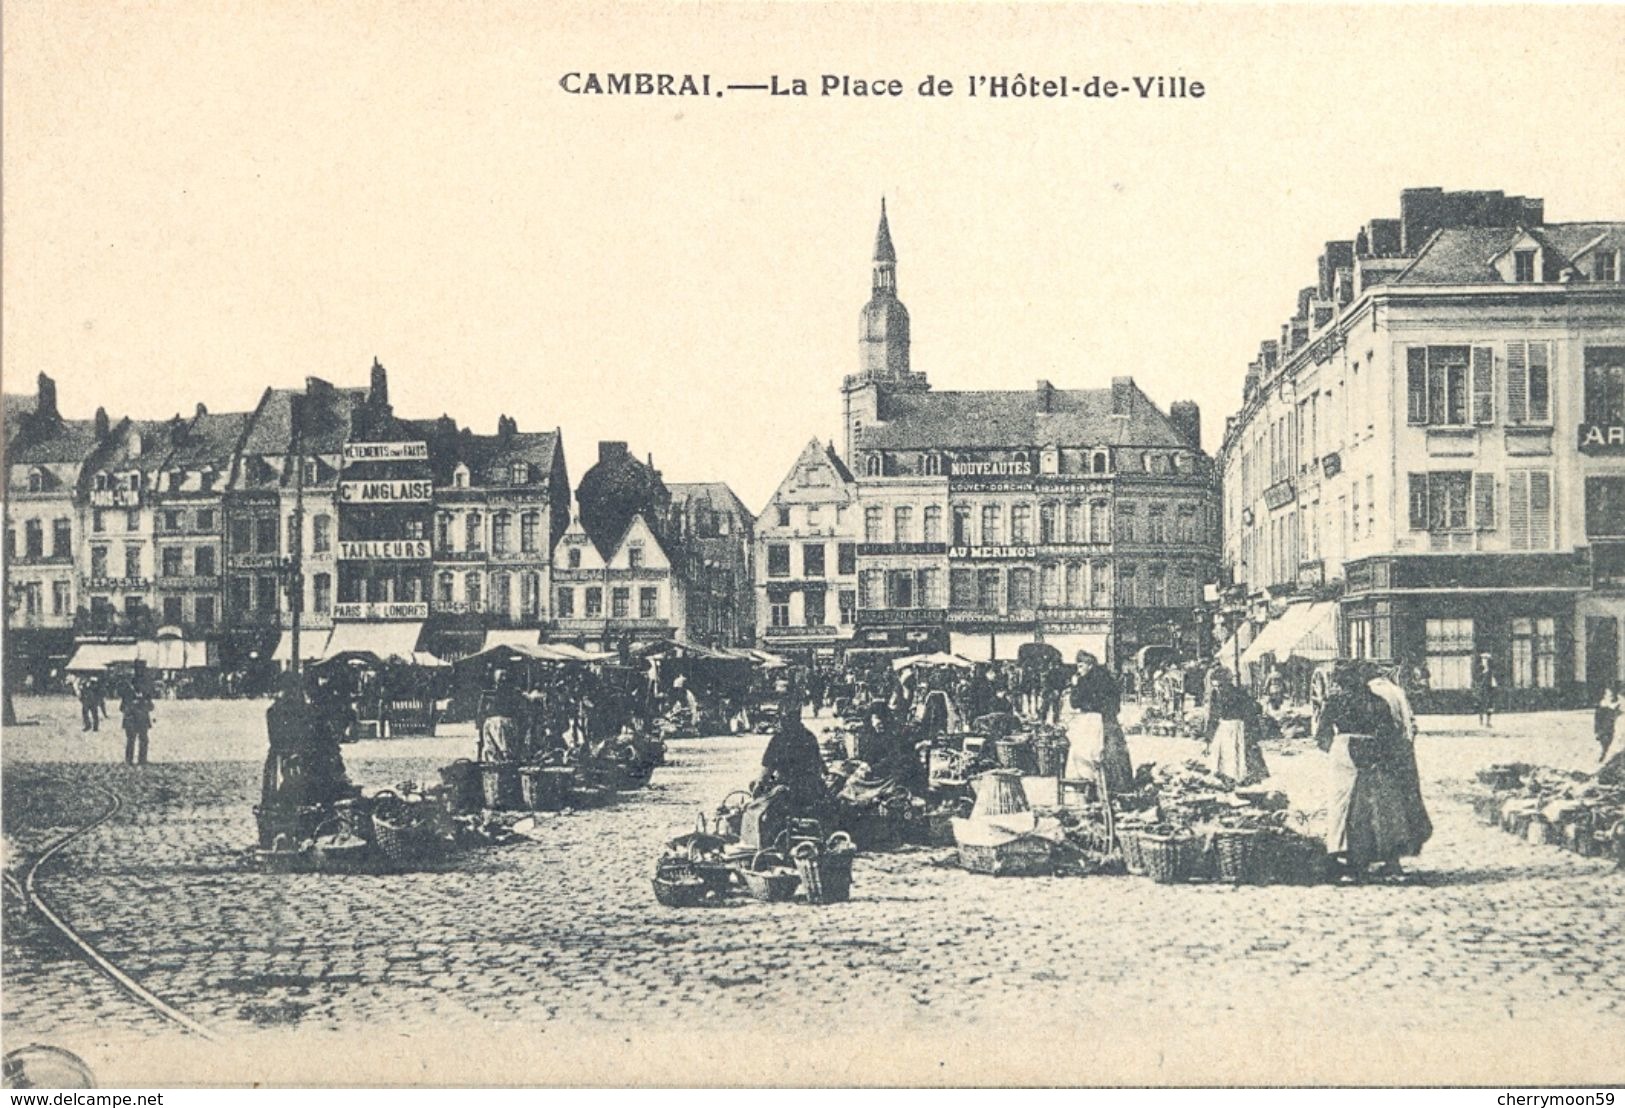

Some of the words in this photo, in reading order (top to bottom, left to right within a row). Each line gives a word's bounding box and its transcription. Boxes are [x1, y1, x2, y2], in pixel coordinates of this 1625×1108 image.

[362, 482, 432, 499] ANGLAISE
[341, 543, 426, 557] TAILLEURS
[949, 547, 967, 557] AU
[333, 605, 361, 617] PARIS
[383, 605, 426, 617] LONDRES
